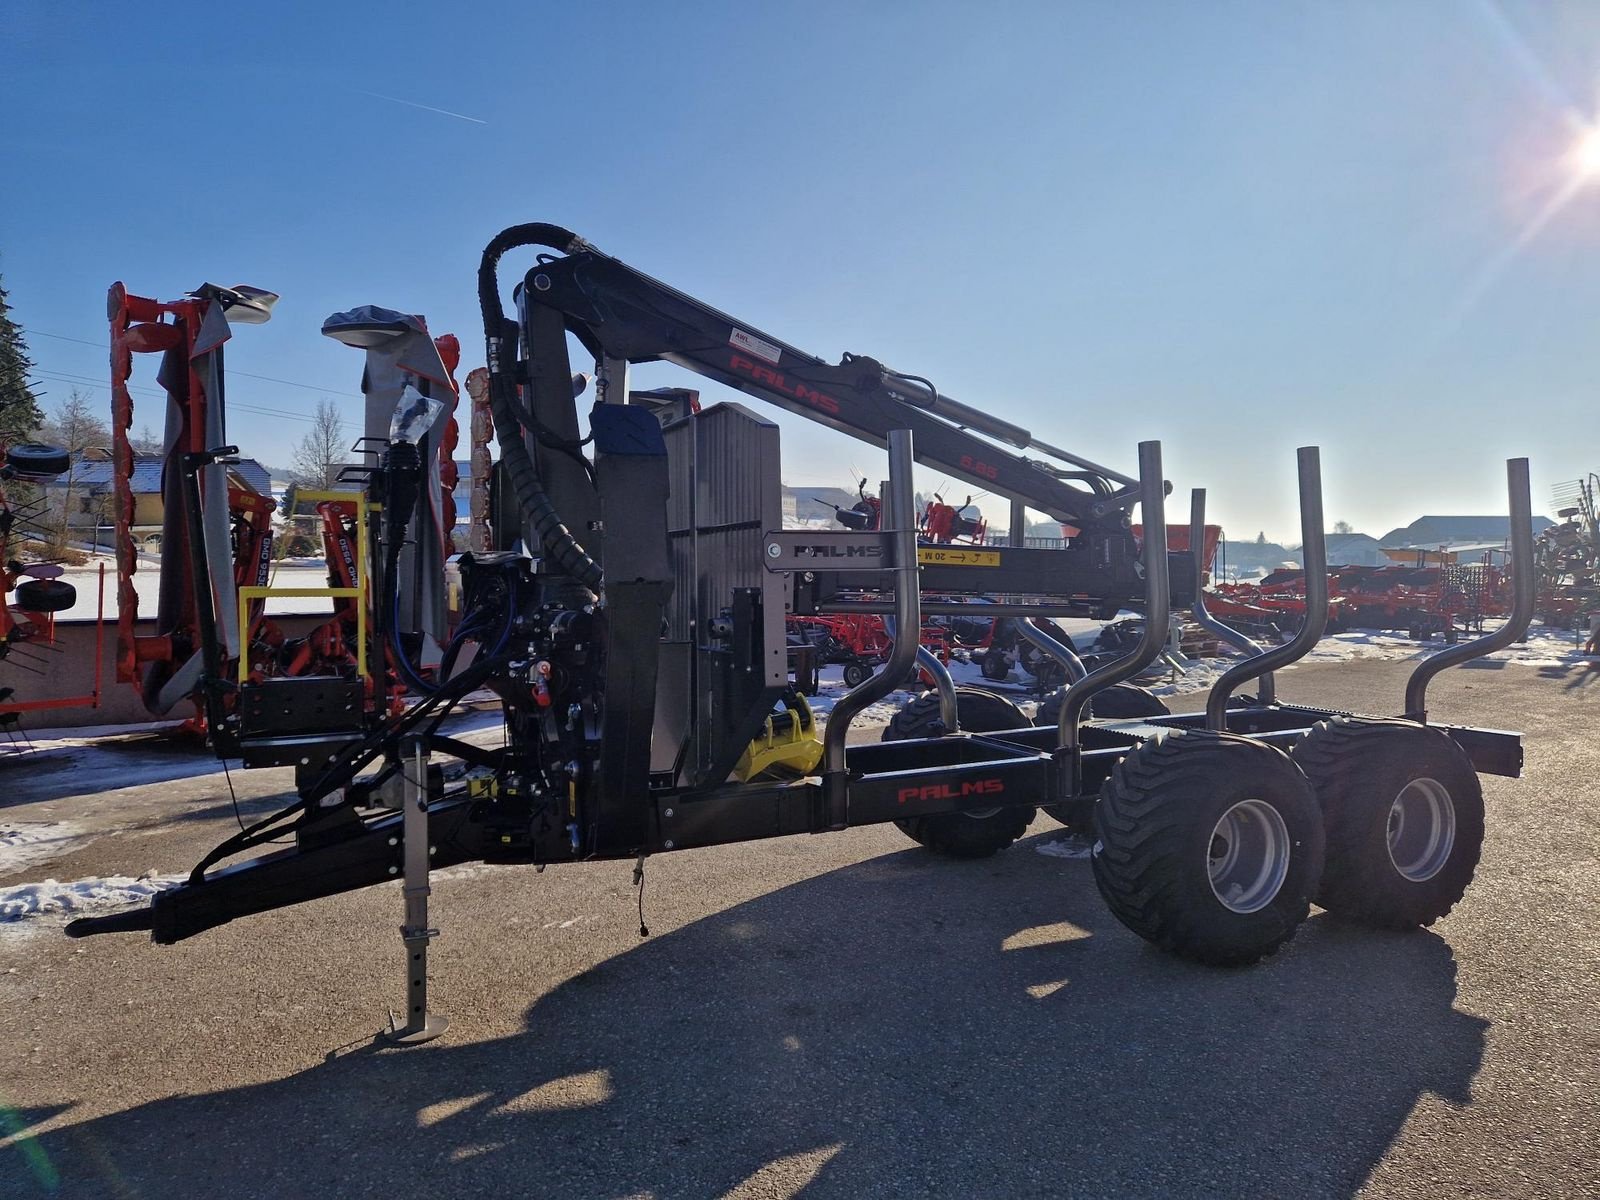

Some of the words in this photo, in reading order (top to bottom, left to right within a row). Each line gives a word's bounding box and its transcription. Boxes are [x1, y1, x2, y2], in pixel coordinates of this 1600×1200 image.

[730, 354, 840, 414] PALMS
[261, 538, 271, 560] GMD
[339, 538, 352, 564] 9530
[793, 545, 884, 559] PALMS
[935, 553, 946, 561] 20
[897, 778, 1004, 804] PALMS
